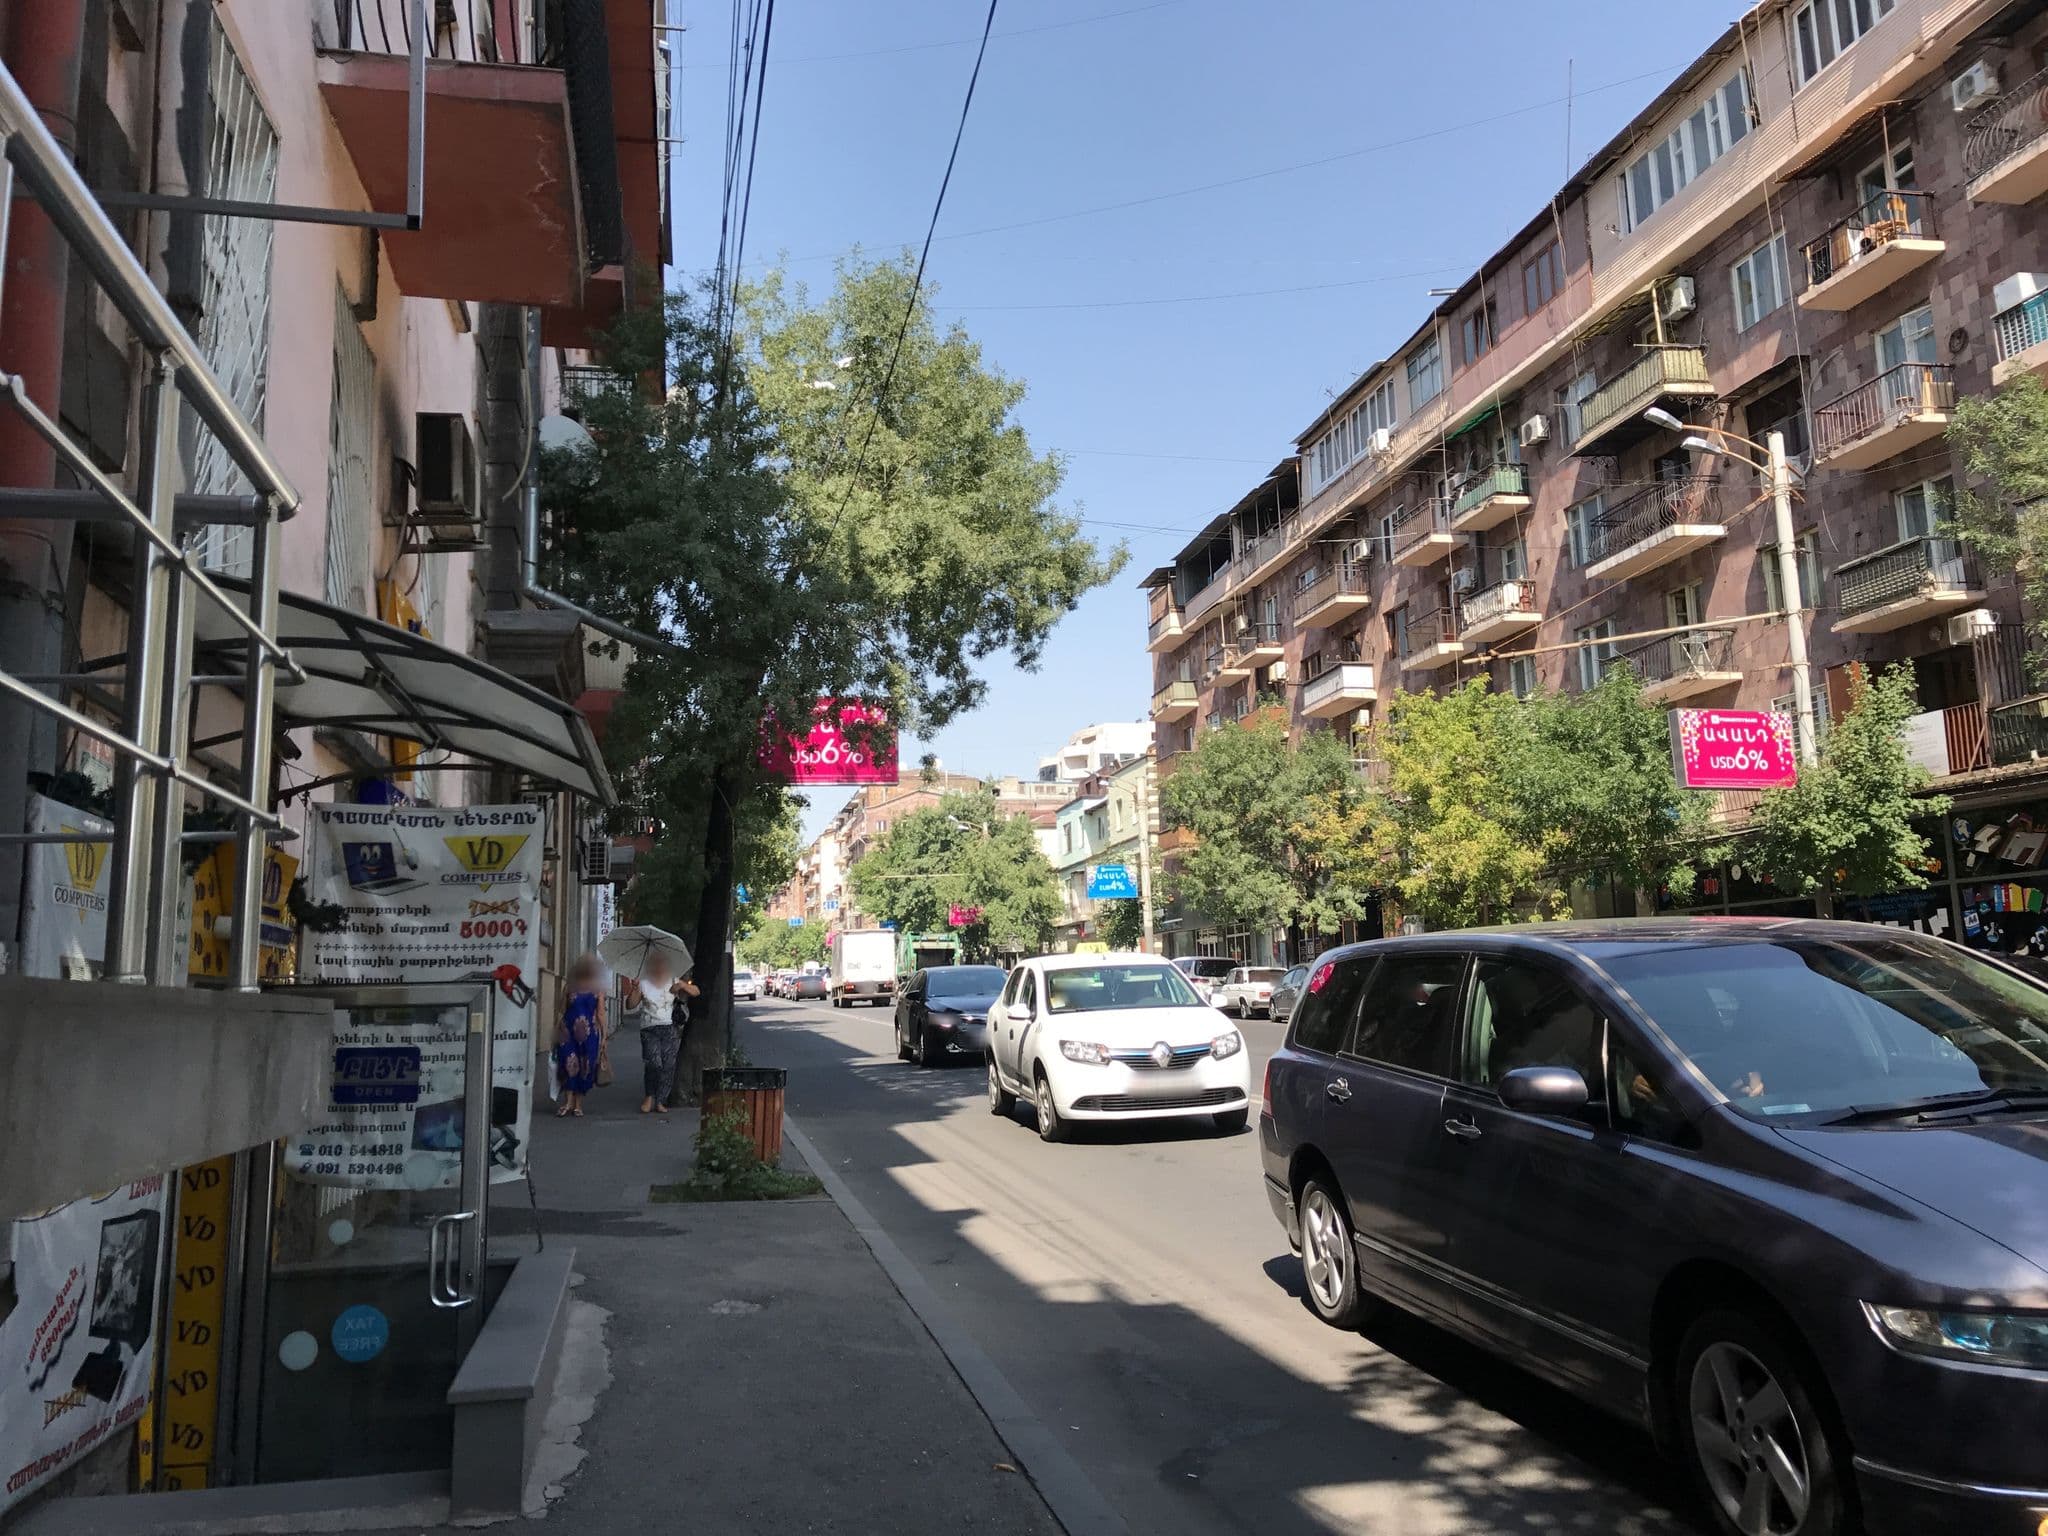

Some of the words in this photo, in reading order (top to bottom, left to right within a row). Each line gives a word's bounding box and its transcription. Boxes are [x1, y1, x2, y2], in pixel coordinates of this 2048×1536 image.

[1704, 727, 1768, 743] ԱՎԱՆԴ
[1709, 746, 1769, 771] USD6%
[454, 809, 537, 827] ԿԵՆՏՐՈՆ
[466, 835, 504, 865] VD
[441, 871, 523, 884] COMPUTERS
[54, 886, 105, 912] COMPUTERS
[354, 1086, 394, 1098] OPEN
[318, 1144, 343, 1157] 010
[349, 1143, 404, 1157] 544818
[184, 1167, 221, 1192] VD
[315, 1162, 341, 1176] 091
[347, 1162, 404, 1176] 520496
[183, 1215, 217, 1241] VD
[178, 1265, 216, 1292] VD
[177, 1320, 212, 1346] VD
[170, 1369, 209, 1398] VD
[170, 1422, 205, 1450] VD
